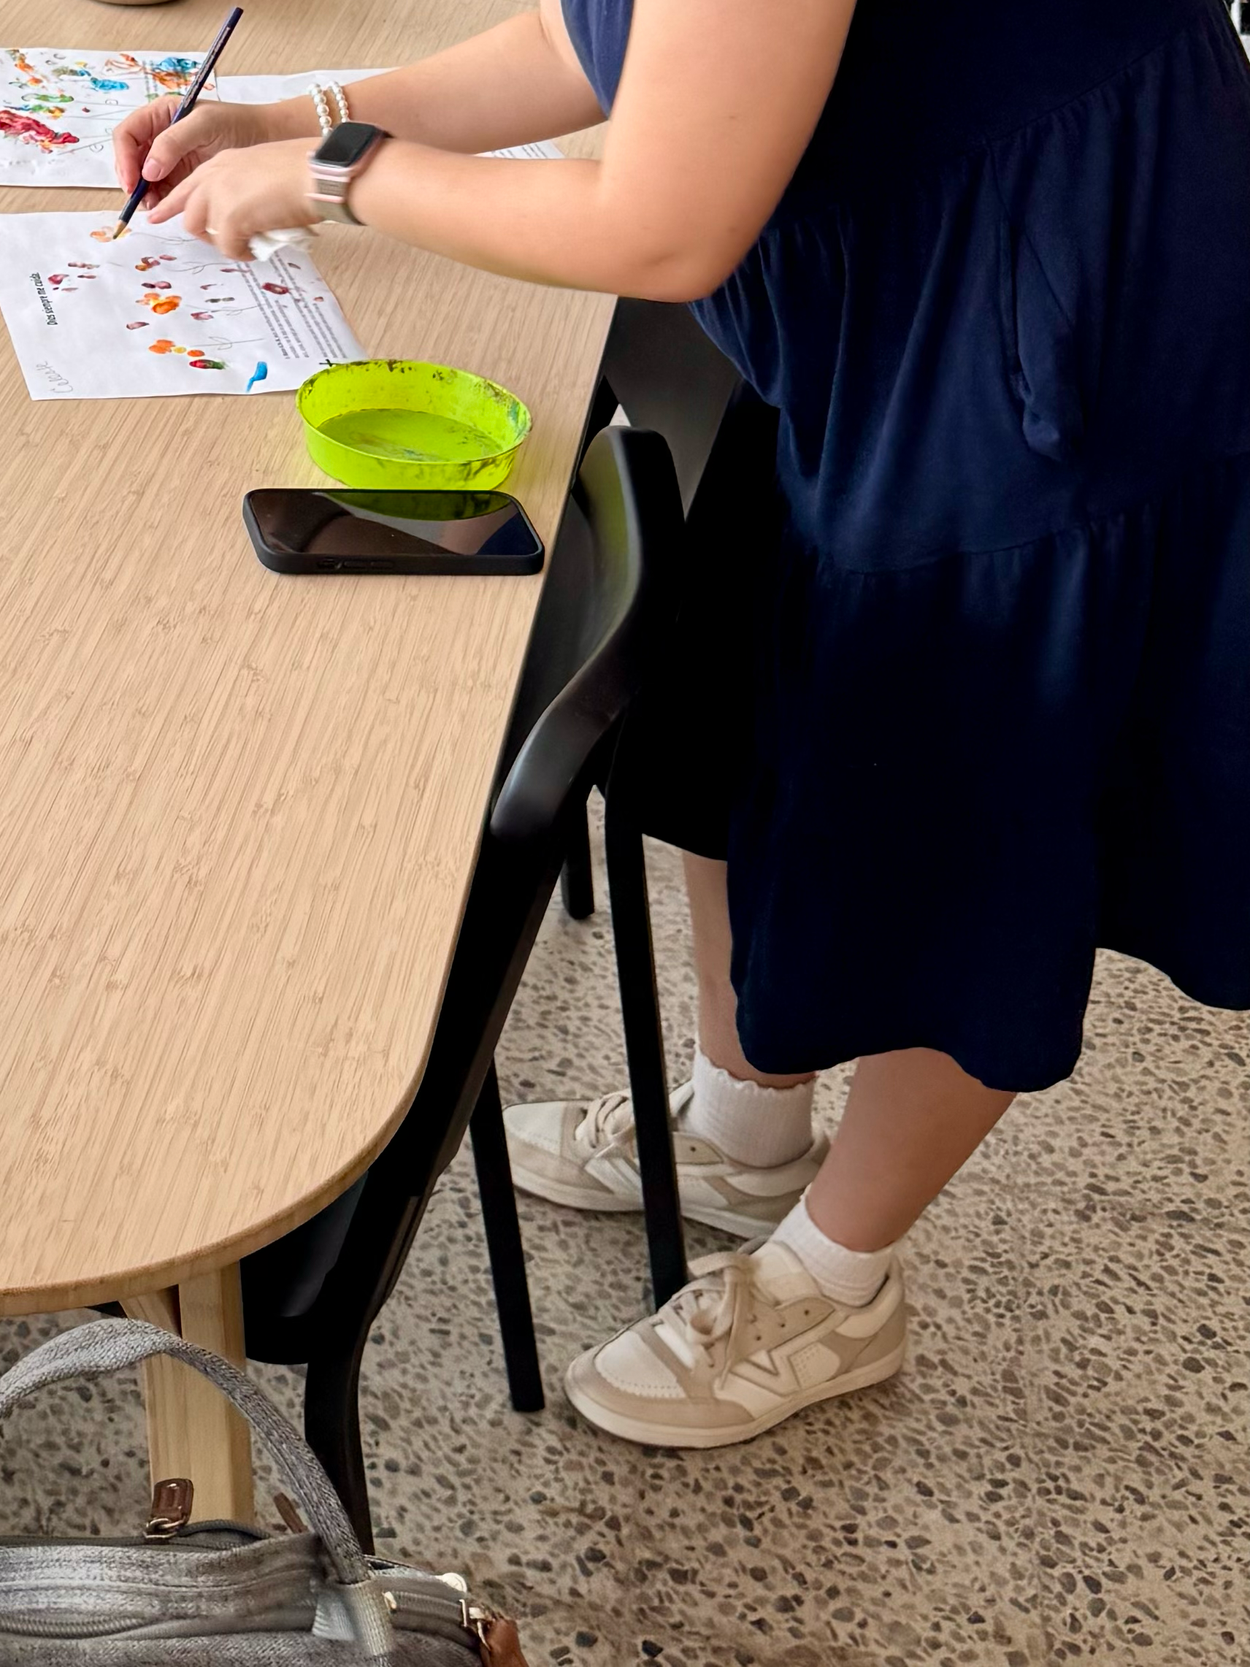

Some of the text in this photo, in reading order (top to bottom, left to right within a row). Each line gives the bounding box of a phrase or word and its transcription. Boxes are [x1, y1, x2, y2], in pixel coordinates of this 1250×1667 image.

[37, 287, 47, 295] me
[40, 296, 54, 314] siempre
[46, 314, 58, 326] Dios
